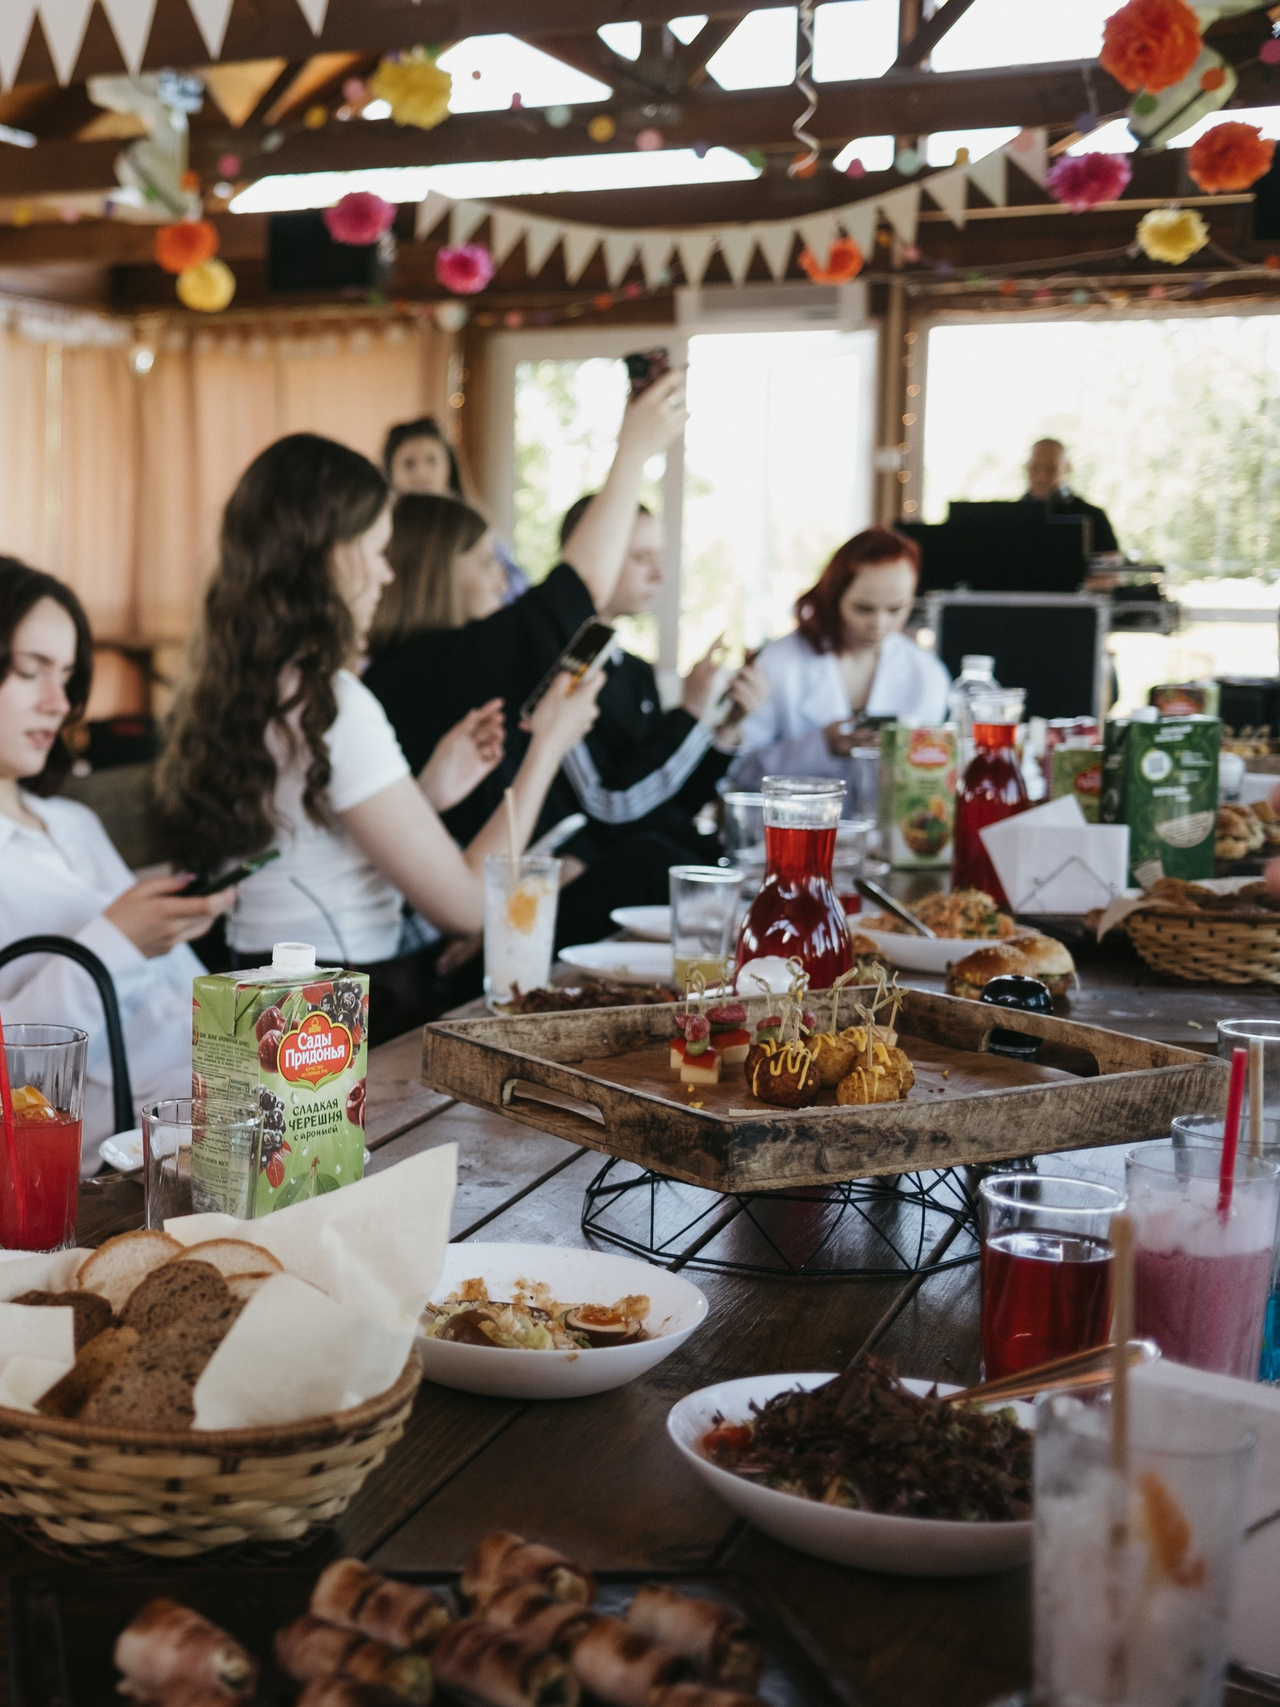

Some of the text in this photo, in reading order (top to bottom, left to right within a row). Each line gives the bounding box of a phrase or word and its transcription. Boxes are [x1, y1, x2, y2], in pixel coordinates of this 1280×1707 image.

[297, 1032, 332, 1050] Сады
[285, 1044, 345, 1070] Придонья
[292, 1098, 338, 1116] СЛАДКАЯ
[288, 1110, 343, 1131] ЧЕРЕШНЯ
[300, 1124, 338, 1142] аронией
